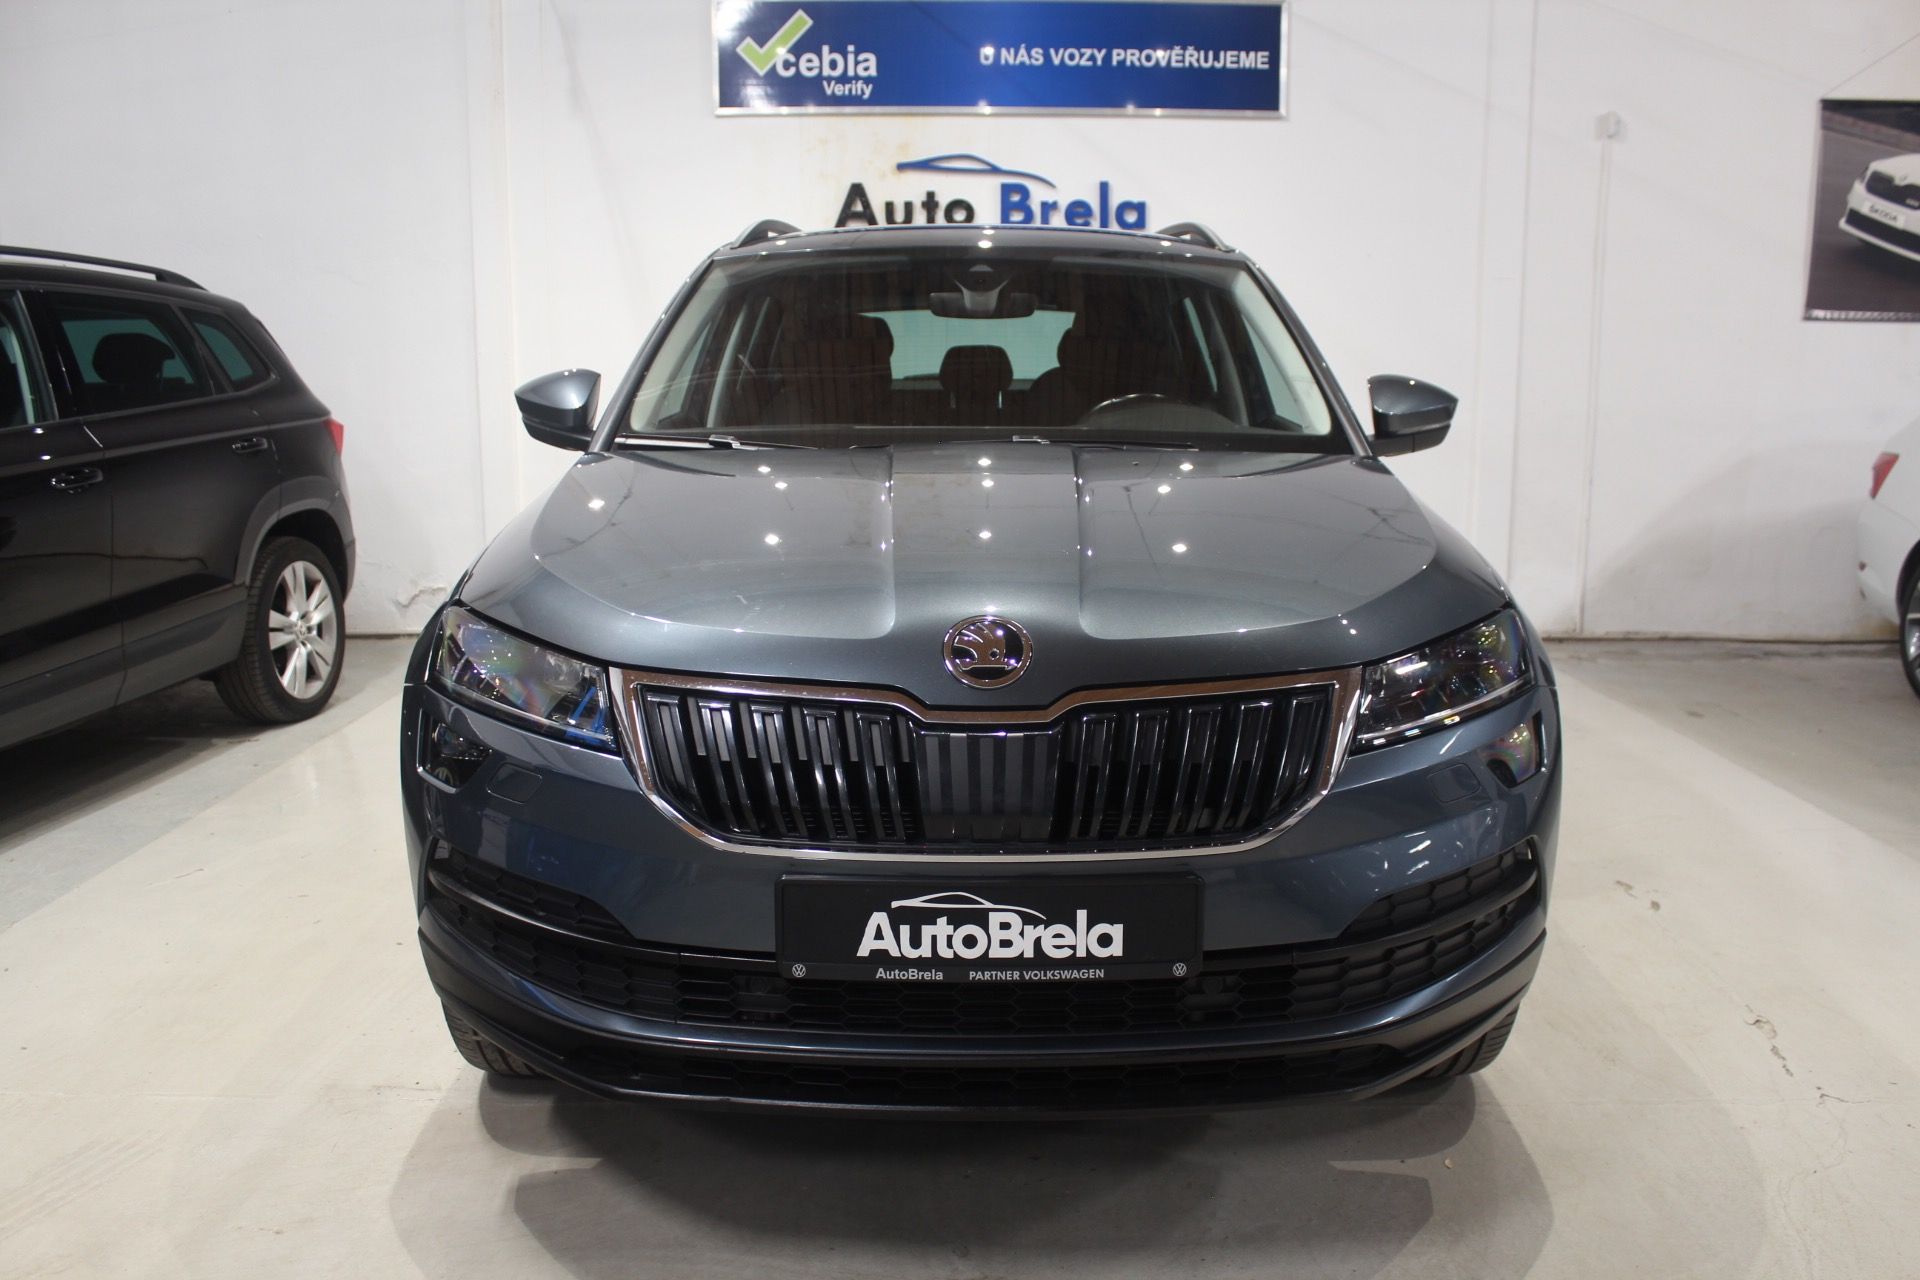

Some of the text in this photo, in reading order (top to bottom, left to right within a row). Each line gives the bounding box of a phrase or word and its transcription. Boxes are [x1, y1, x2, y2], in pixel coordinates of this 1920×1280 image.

[776, 45, 877, 77] cebia
[1000, 44, 1044, 65] NÁS
[1050, 49, 1106, 66] VOZY
[1112, 47, 1269, 70] PROVĚŘUJEME
[824, 80, 873, 99] Verify
[835, 181, 1146, 229] Auto Brela
[856, 909, 1123, 959] AutoBrela
[876, 968, 943, 980] AutoBrela
[969, 969, 1104, 981] PARTNER VOLKSWAGEN
